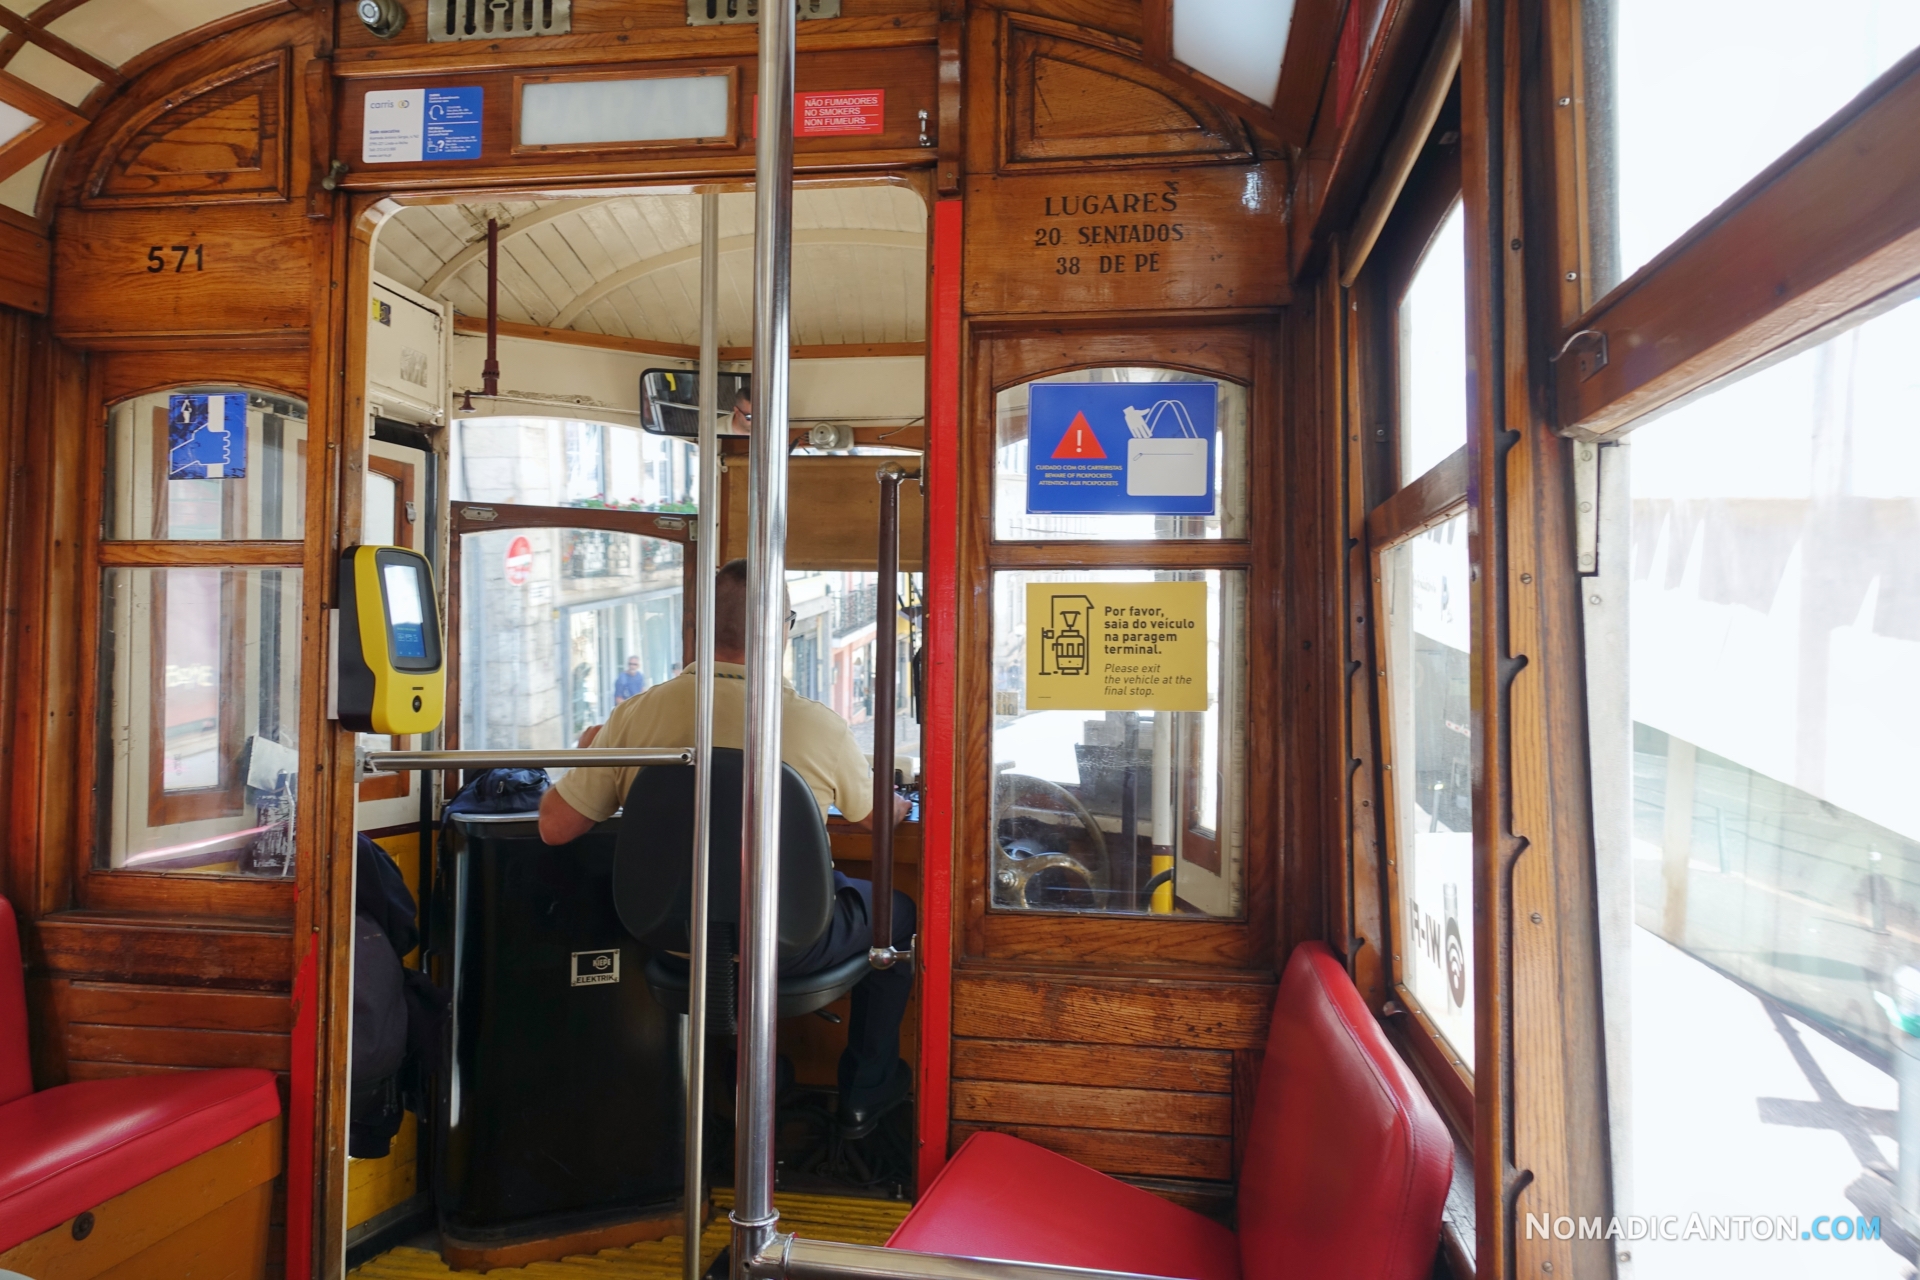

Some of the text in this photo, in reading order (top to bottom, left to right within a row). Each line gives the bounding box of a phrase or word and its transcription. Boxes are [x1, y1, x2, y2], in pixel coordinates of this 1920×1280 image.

[804, 97, 878, 107] NÃO FUMADORES
[804, 107, 861, 117] NO SMOKERS
[804, 116, 866, 127] NON FUMEURS
[1045, 192, 1178, 217] LUGARES
[1034, 223, 1184, 246] 20 SENTADOS
[146, 244, 204, 273] 571
[1056, 256, 1081, 275] 38
[1099, 254, 1126, 273] DE
[1104, 606, 1164, 618] Por favor,
[1104, 618, 1195, 629] saia do veículo
[1104, 633, 1178, 644] na paragem
[1104, 644, 1162, 655] terminal.
[1104, 663, 1161, 673] Please exit
[1104, 675, 1192, 685] the vehicle at the
[1104, 686, 1155, 698] final stop.
[576, 974, 614, 983] ELEKTRIK
